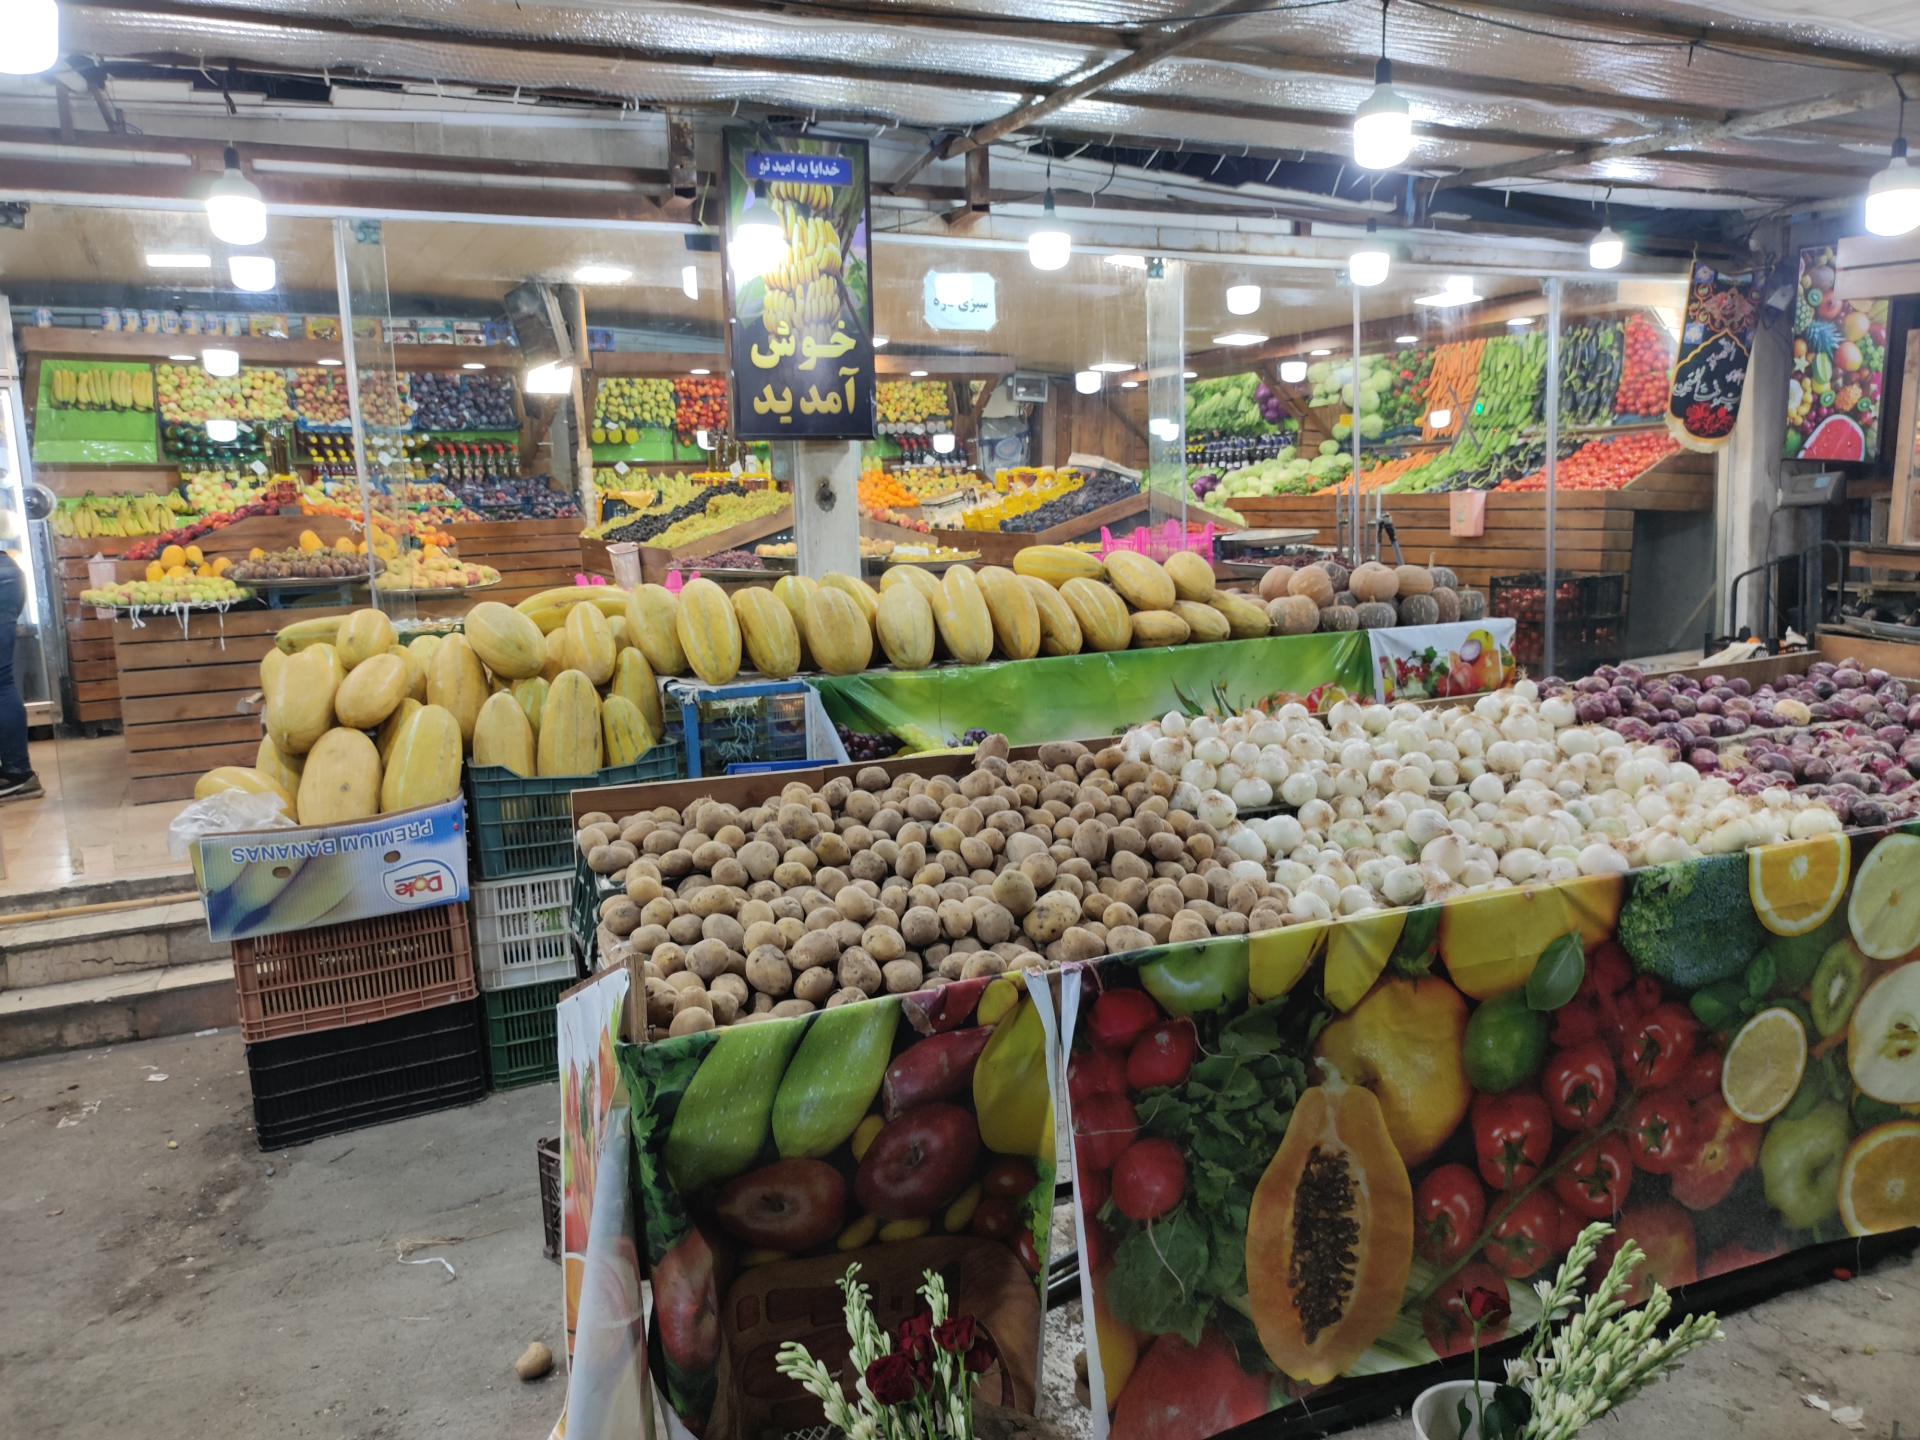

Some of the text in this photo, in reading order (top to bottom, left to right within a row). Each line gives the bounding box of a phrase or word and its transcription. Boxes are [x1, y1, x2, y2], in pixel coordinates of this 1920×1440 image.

[758, 157, 840, 178] خدایا به امید تو
[751, 319, 857, 370] خوش
[753, 367, 860, 424] آمدید
[231, 818, 434, 864] PREMIUM BANANAS
[395, 874, 443, 897] Dole
